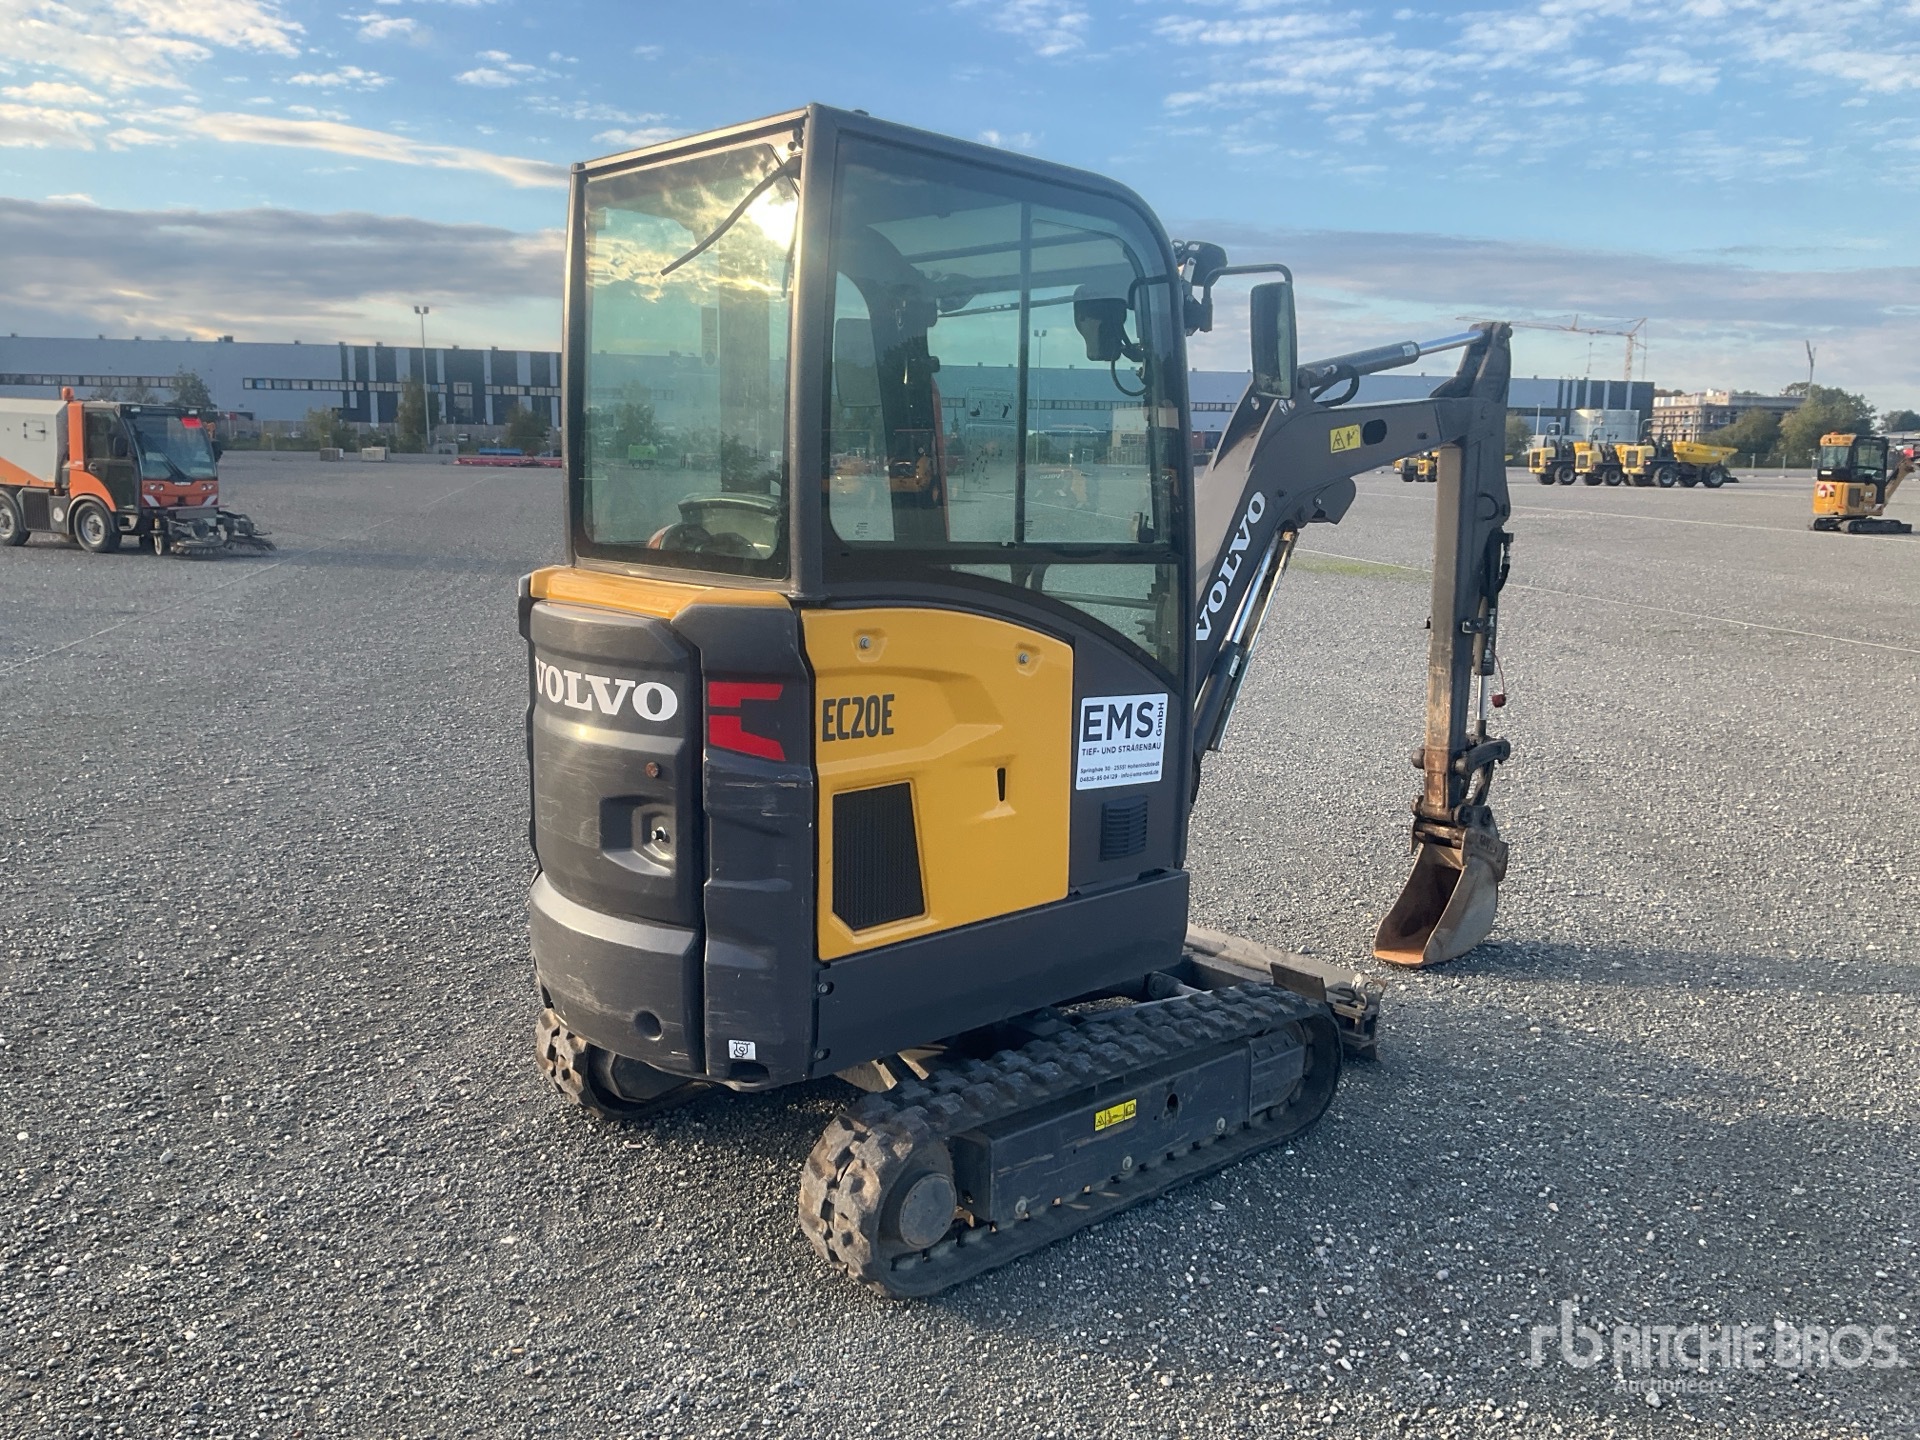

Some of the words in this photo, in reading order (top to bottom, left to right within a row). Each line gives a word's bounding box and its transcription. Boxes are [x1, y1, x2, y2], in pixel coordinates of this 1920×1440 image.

[1195, 491, 1266, 641] VOLVO
[534, 656, 678, 722] VOLVO
[821, 693, 895, 742] EC20E
[1082, 701, 1154, 742] EMS
[1156, 702, 1165, 737] GmbH
[1082, 748, 1100, 756] TIEF-
[1102, 746, 1117, 754] UND
